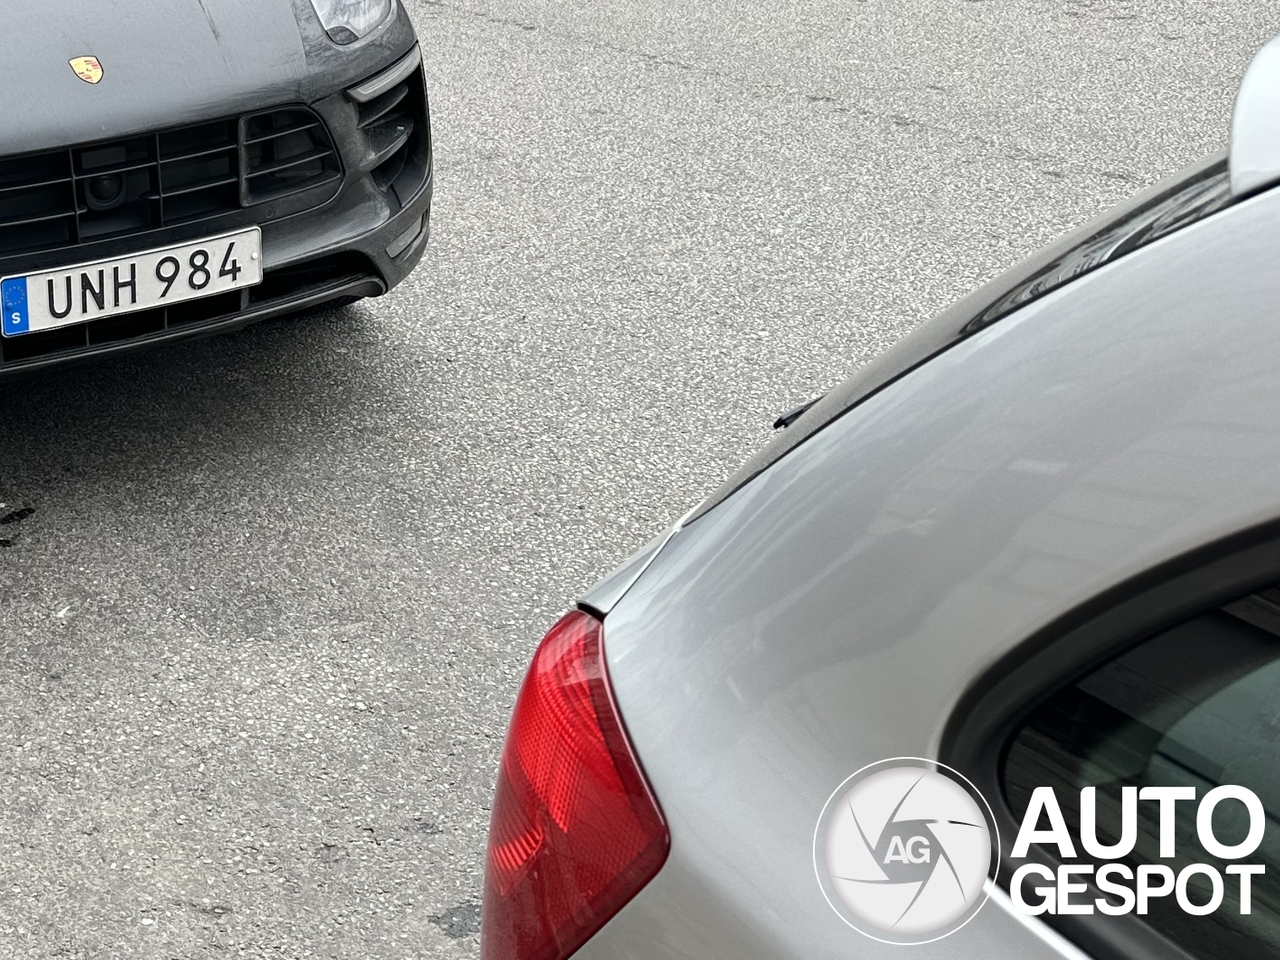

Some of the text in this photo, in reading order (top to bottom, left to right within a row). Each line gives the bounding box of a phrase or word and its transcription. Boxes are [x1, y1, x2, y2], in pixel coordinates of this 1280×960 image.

[47, 241, 242, 319] UNH 984
[11, 312, 21, 324] S
